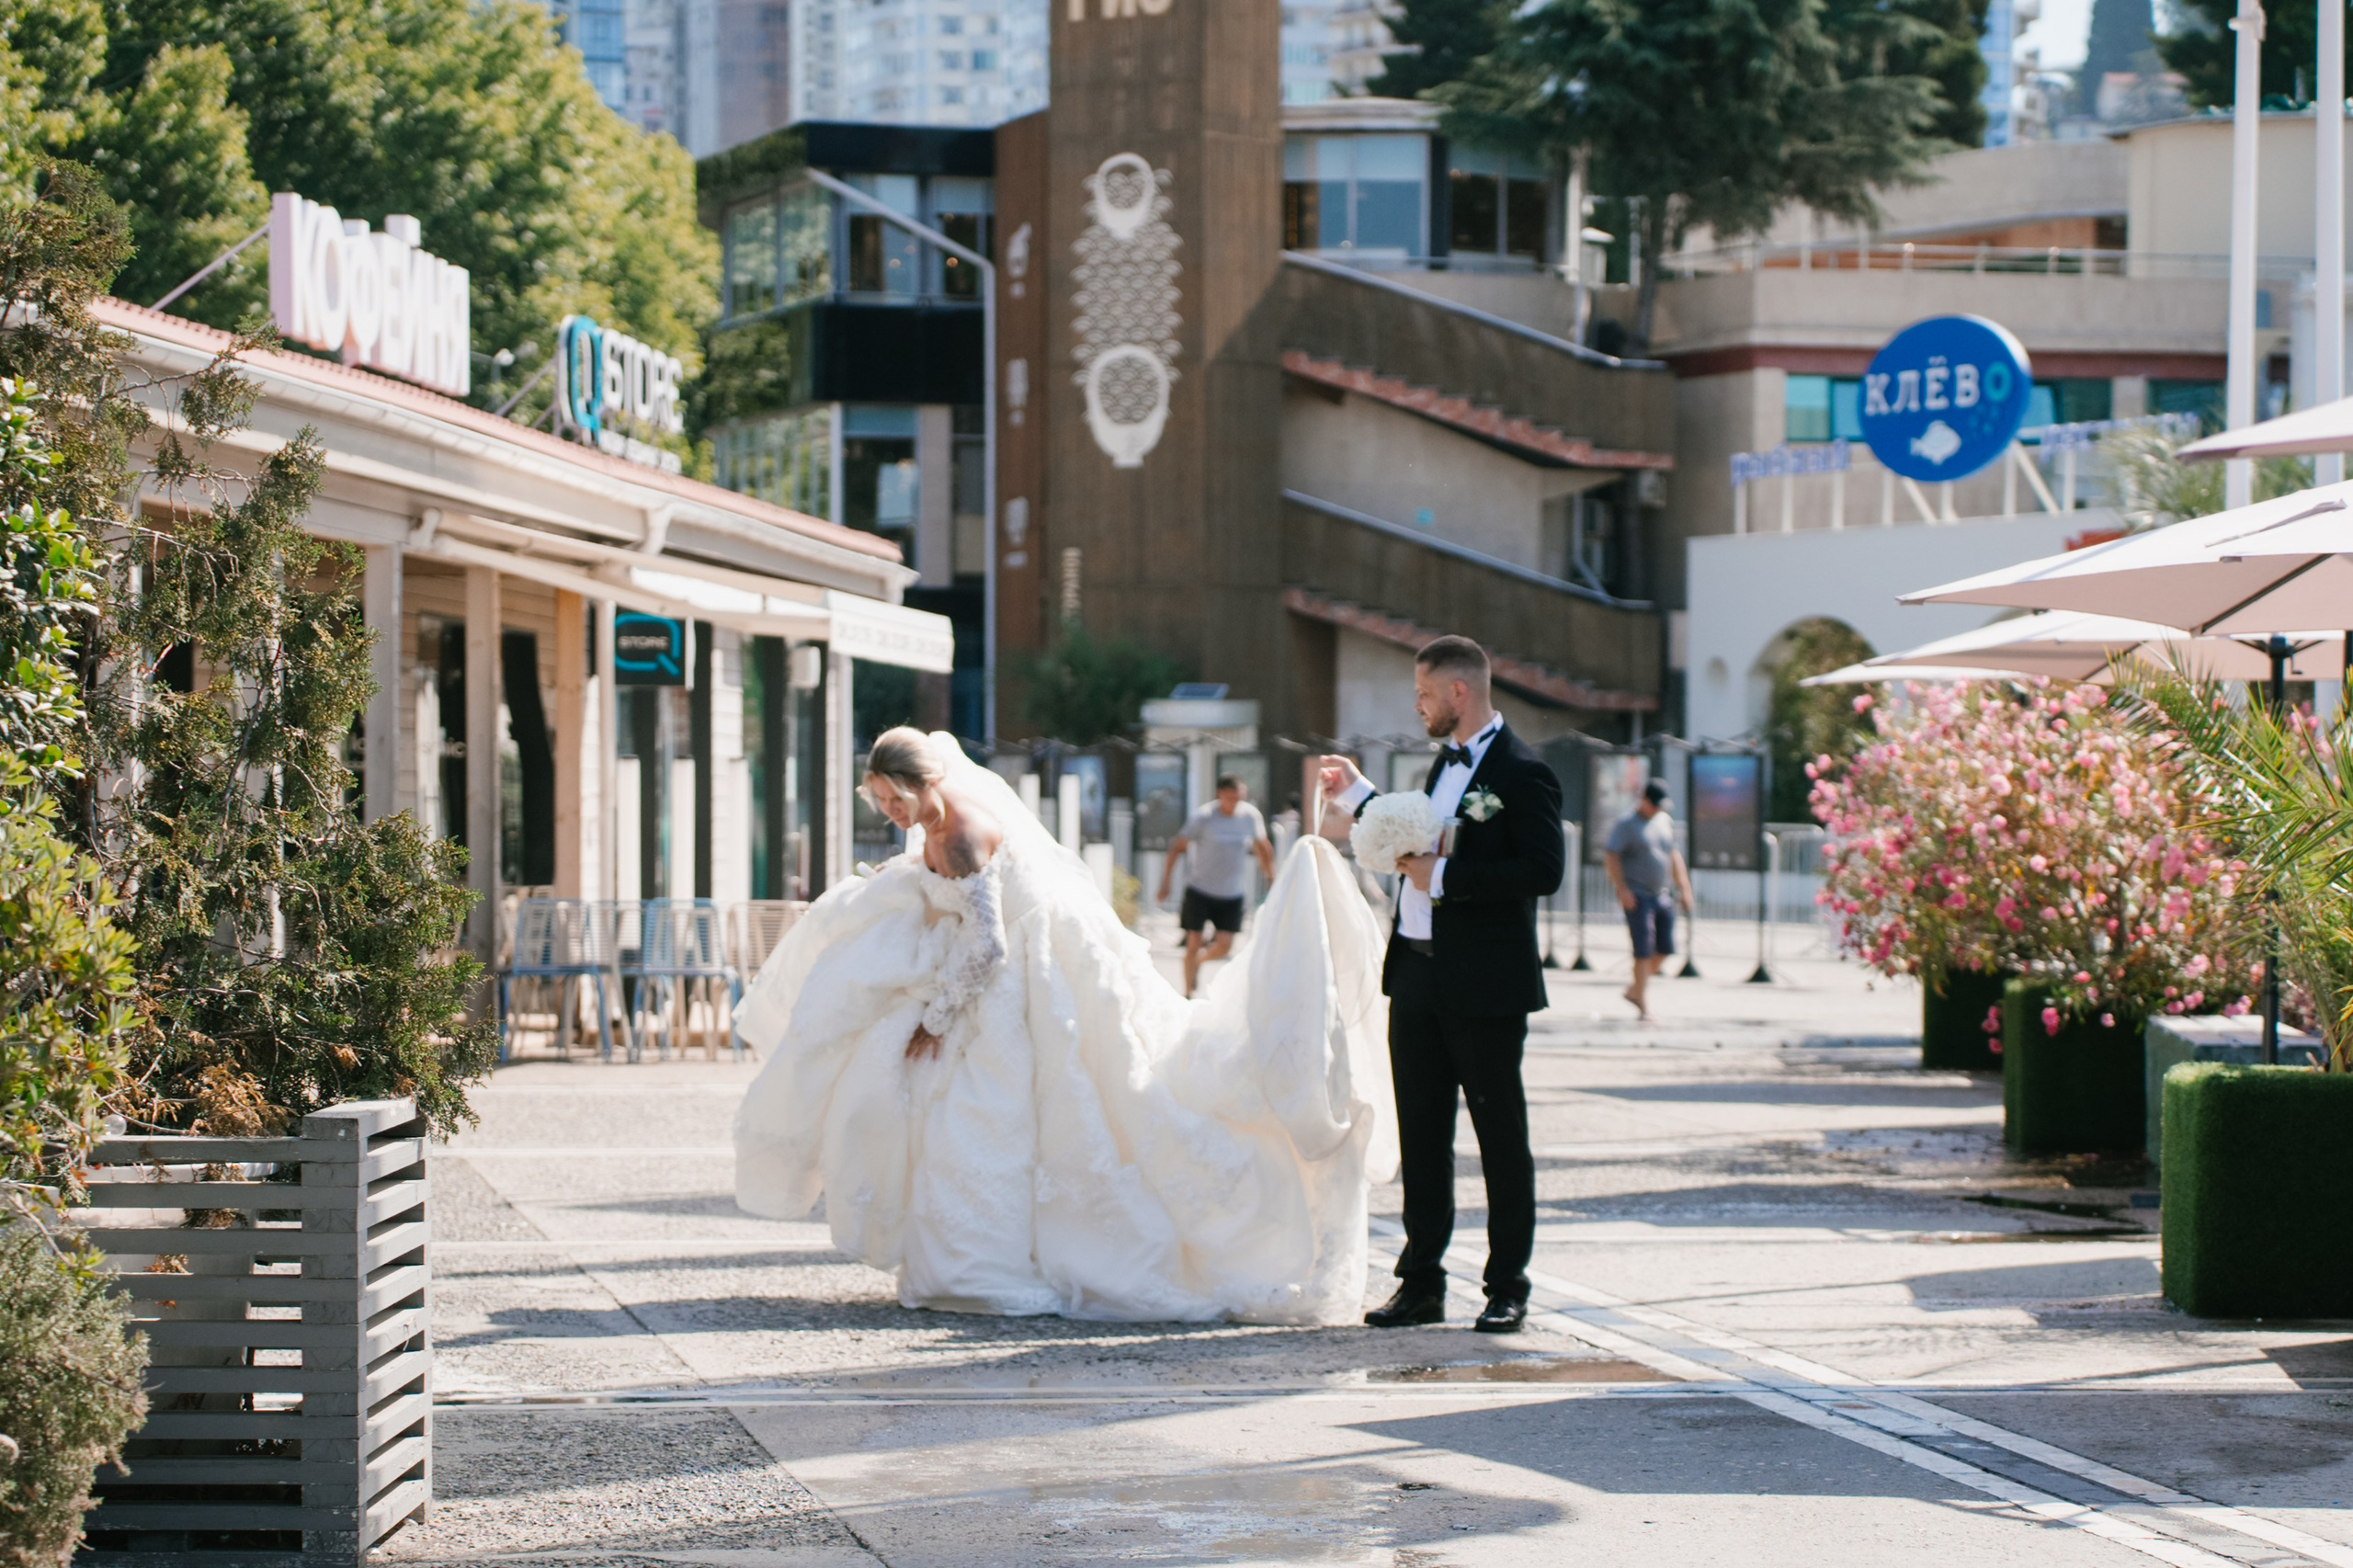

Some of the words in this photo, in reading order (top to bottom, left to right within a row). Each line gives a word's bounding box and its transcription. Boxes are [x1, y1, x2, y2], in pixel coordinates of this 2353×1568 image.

[270, 192, 472, 397] КОФЕЙНЯ
[1864, 355, 2012, 416] КЛЁВО
[618, 635, 669, 650] STORE
